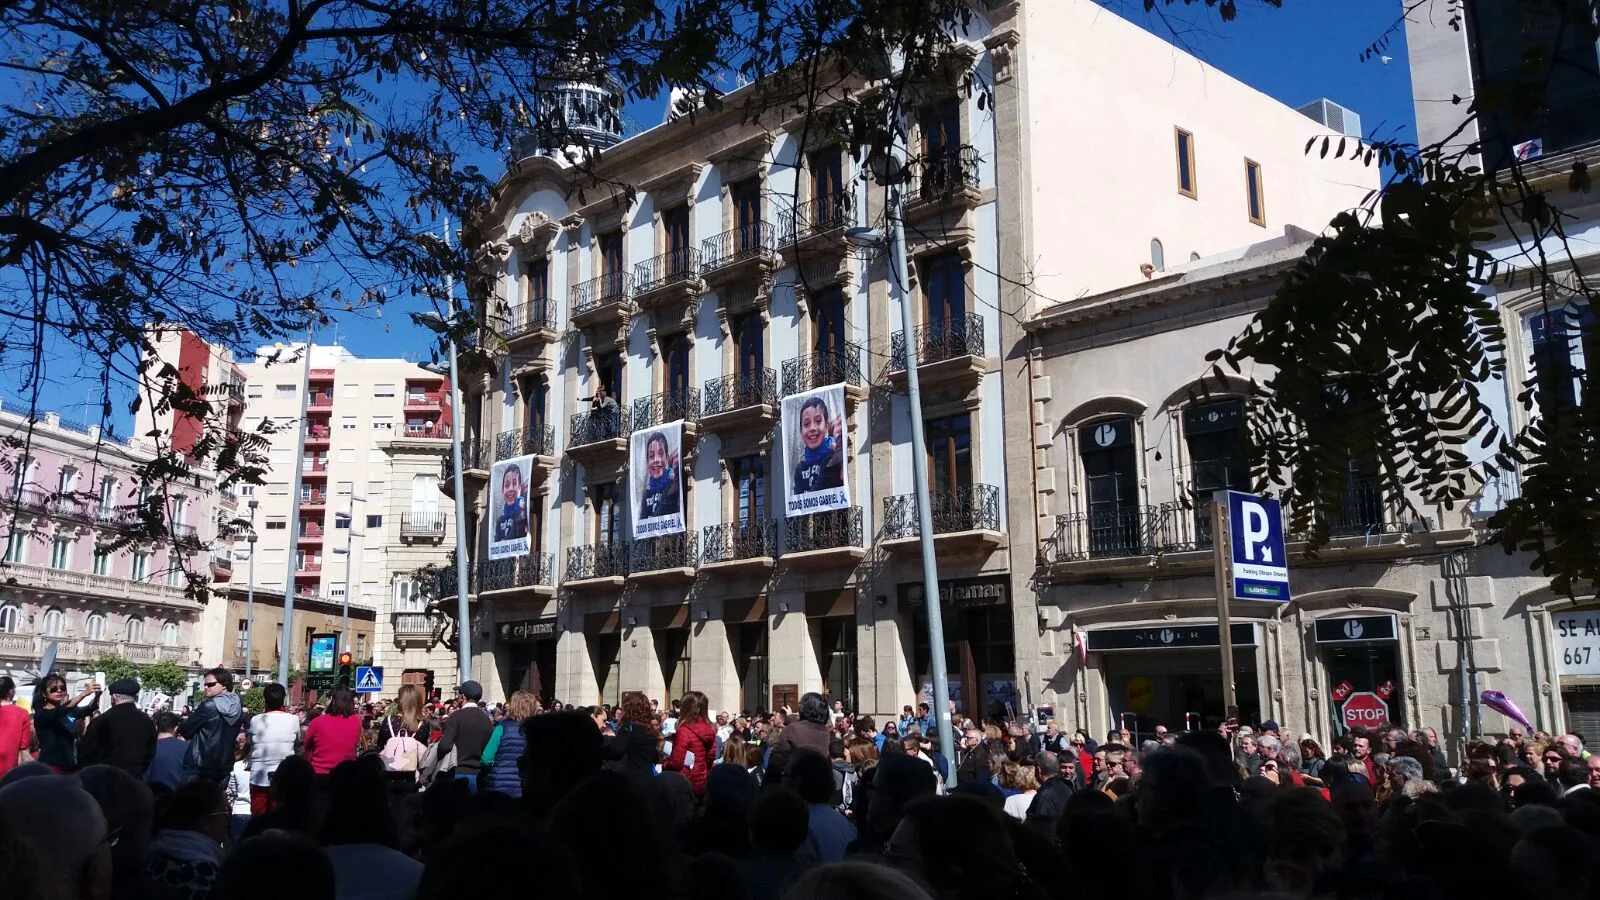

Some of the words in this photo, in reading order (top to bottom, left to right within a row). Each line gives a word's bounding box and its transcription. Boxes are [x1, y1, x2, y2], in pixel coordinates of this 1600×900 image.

[788, 499, 803, 511] TODOS
[803, 497, 819, 509] SOMOS
[819, 493, 839, 506] GABRIEL
[1241, 500, 1270, 561] P
[513, 621, 555, 640] cajamar
[1135, 628, 1201, 644] SUPER
[1558, 619, 1577, 637] SE
[1564, 646, 1591, 665] 667
[1346, 708, 1385, 721] STOP
